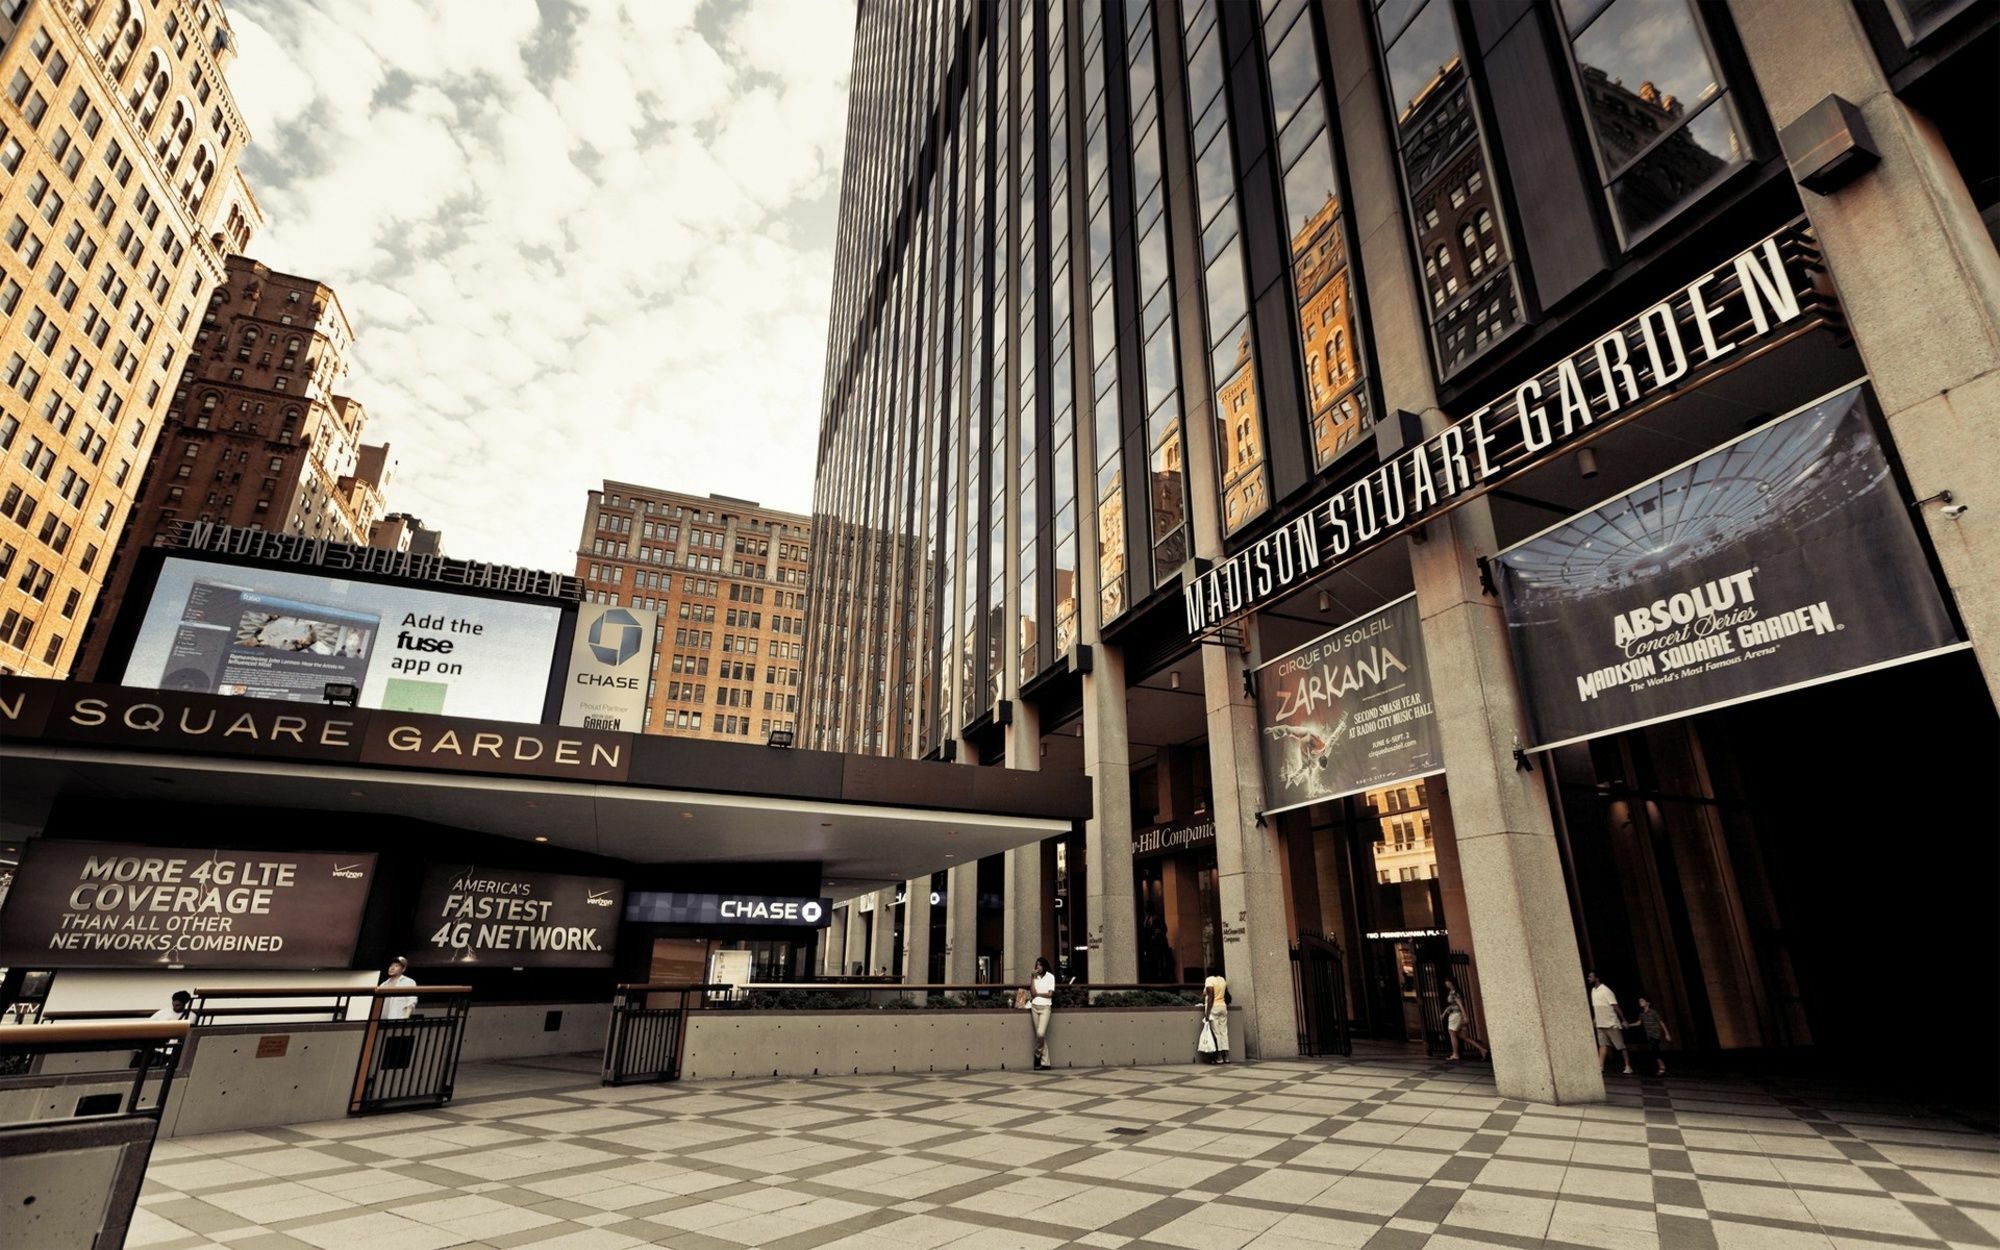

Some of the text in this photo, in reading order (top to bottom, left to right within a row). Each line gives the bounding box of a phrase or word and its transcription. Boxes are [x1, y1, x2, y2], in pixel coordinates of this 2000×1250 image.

[1186, 238, 1800, 635] MADISON SQUARE GARDEN
[187, 520, 564, 598] MADISON SQUARE GARDEN
[1614, 569, 1756, 646] ABSOLUT
[401, 612, 484, 636] Add the
[1618, 606, 1759, 660] Concert Series
[396, 630, 454, 654] fuse
[1278, 618, 1394, 677] CIRQUE DU SOLEIL
[1577, 601, 1836, 702] MADISON SQUARE GARDEN
[391, 656, 463, 675] app on
[1629, 646, 1776, 694] The World's Most Famous Arena
[577, 673, 639, 689] CHASE
[1275, 645, 1408, 721] ZARKANA
[583, 715, 621, 731] GARDEN
[1348, 702, 1433, 739] AT RADIO CITY MUSIC HALL
[1353, 707, 1379, 725] SECOND
[1379, 699, 1401, 716] SMASH
[1402, 692, 1422, 709] YEAR
[70, 699, 354, 747] SQUARE
[387, 726, 621, 768] GARDEN
[1161, 818, 1215, 849] Companie
[80, 855, 298, 888] MORE 4G LTE
[332, 869, 364, 879] verizon
[69, 883, 274, 914] COVERAGE
[452, 878, 531, 896] AMERICA'S
[586, 897, 613, 907] verizon
[60, 913, 233, 933] THAN ALL OTHER
[441, 895, 552, 922] FASTEST
[720, 900, 798, 920] CHASE
[49, 934, 284, 952] NETWORKS COMBINED
[430, 922, 602, 952] 4G NETWORK.
[5, 1002, 40, 1014] ATM
